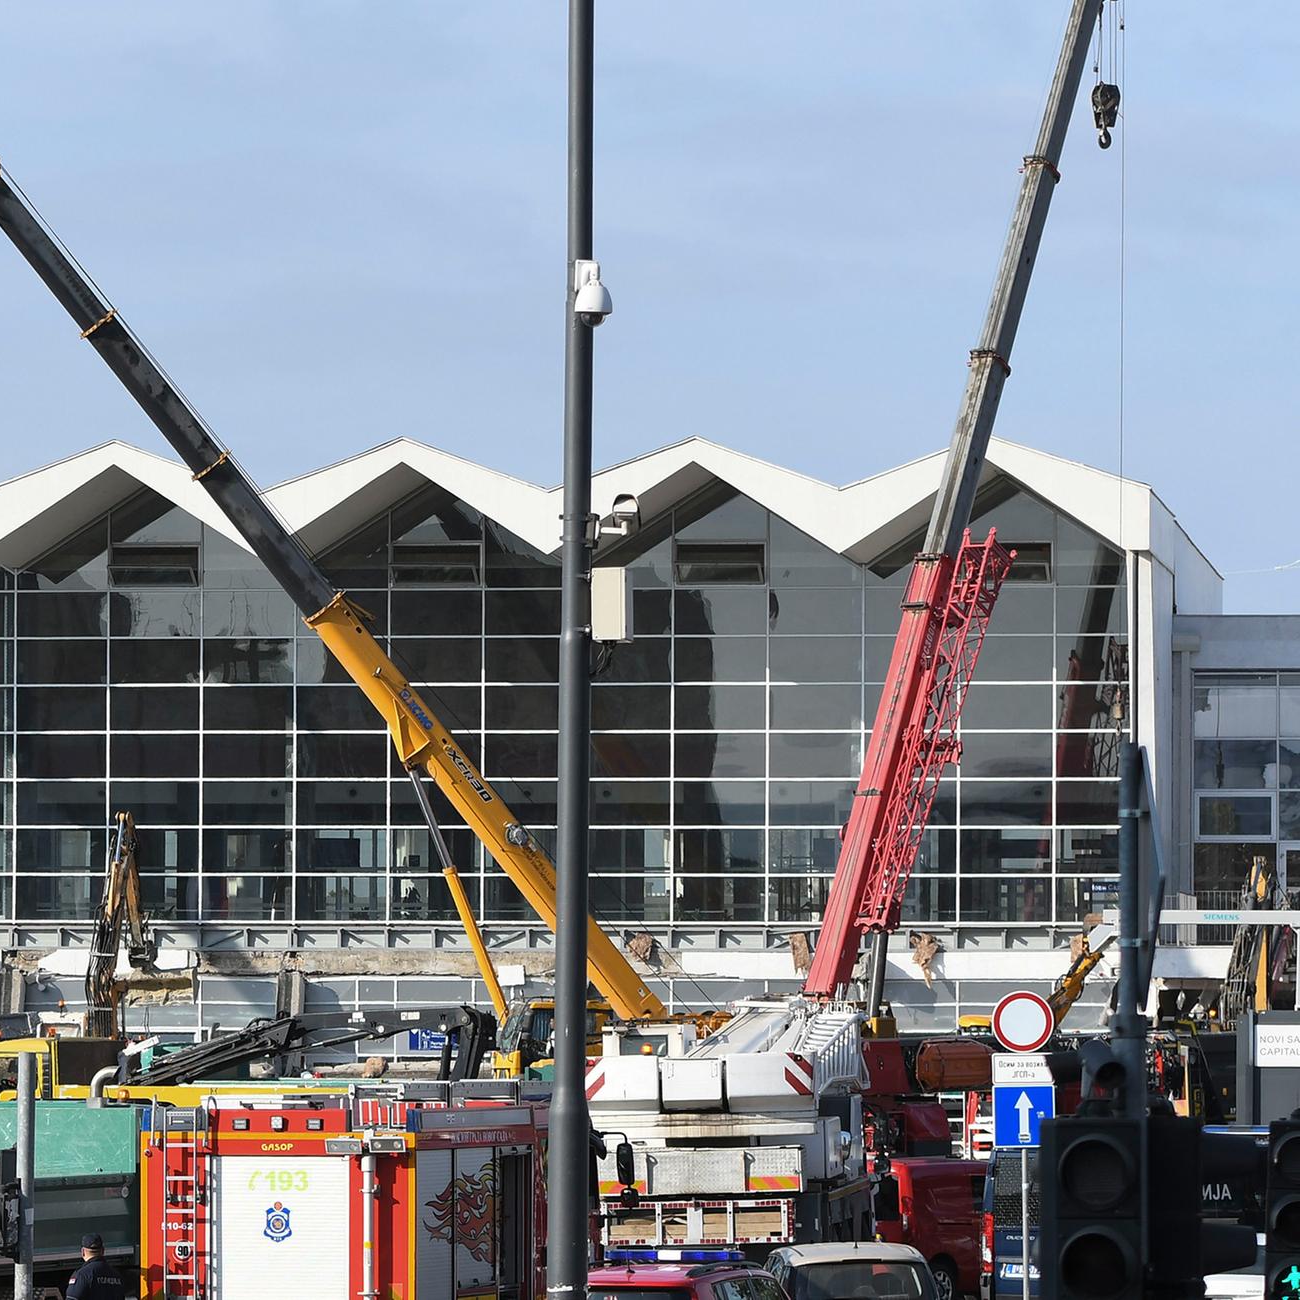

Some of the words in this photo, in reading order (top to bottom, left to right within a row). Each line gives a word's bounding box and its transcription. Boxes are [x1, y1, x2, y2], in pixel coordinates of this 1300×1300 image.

[408, 700, 434, 730] XCMG
[1203, 913, 1240, 921] SIEMENS
[1259, 1035, 1285, 1044] NOVI
[998, 1060, 1016, 1068] Осим
[261, 1143, 294, 1151] GASOP
[264, 1169, 309, 1192] 193
[1202, 1183, 1232, 1201] ИЈА
[177, 1245, 189, 1257] 90
